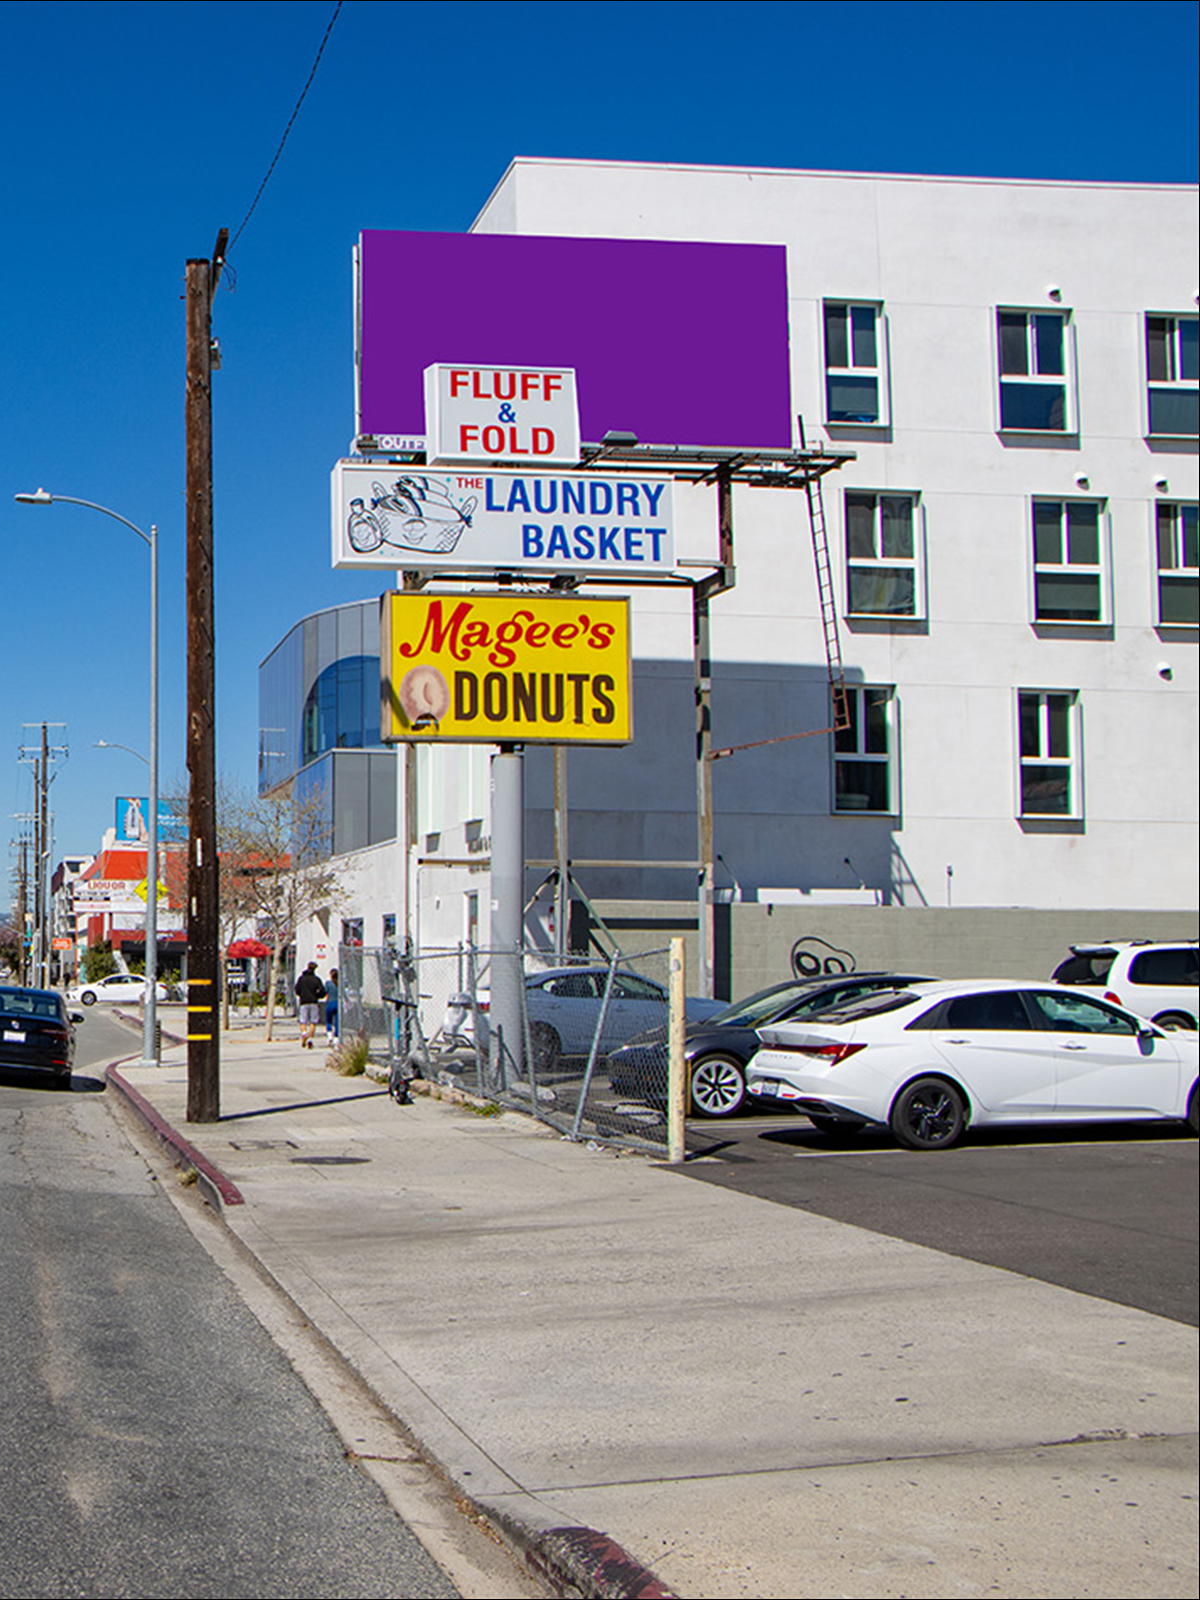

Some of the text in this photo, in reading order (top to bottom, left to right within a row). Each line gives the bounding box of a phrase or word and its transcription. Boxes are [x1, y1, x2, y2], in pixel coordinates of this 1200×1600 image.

[450, 370, 562, 402] FLUFF
[498, 402, 517, 424] &
[459, 424, 556, 456] FOLD
[456, 477, 665, 517] THE LAUNDRY
[522, 523, 667, 562] BASKET
[399, 600, 616, 668] Magee's
[453, 671, 616, 725] DONUTS
[87, 881, 126, 890] LIQUOR
